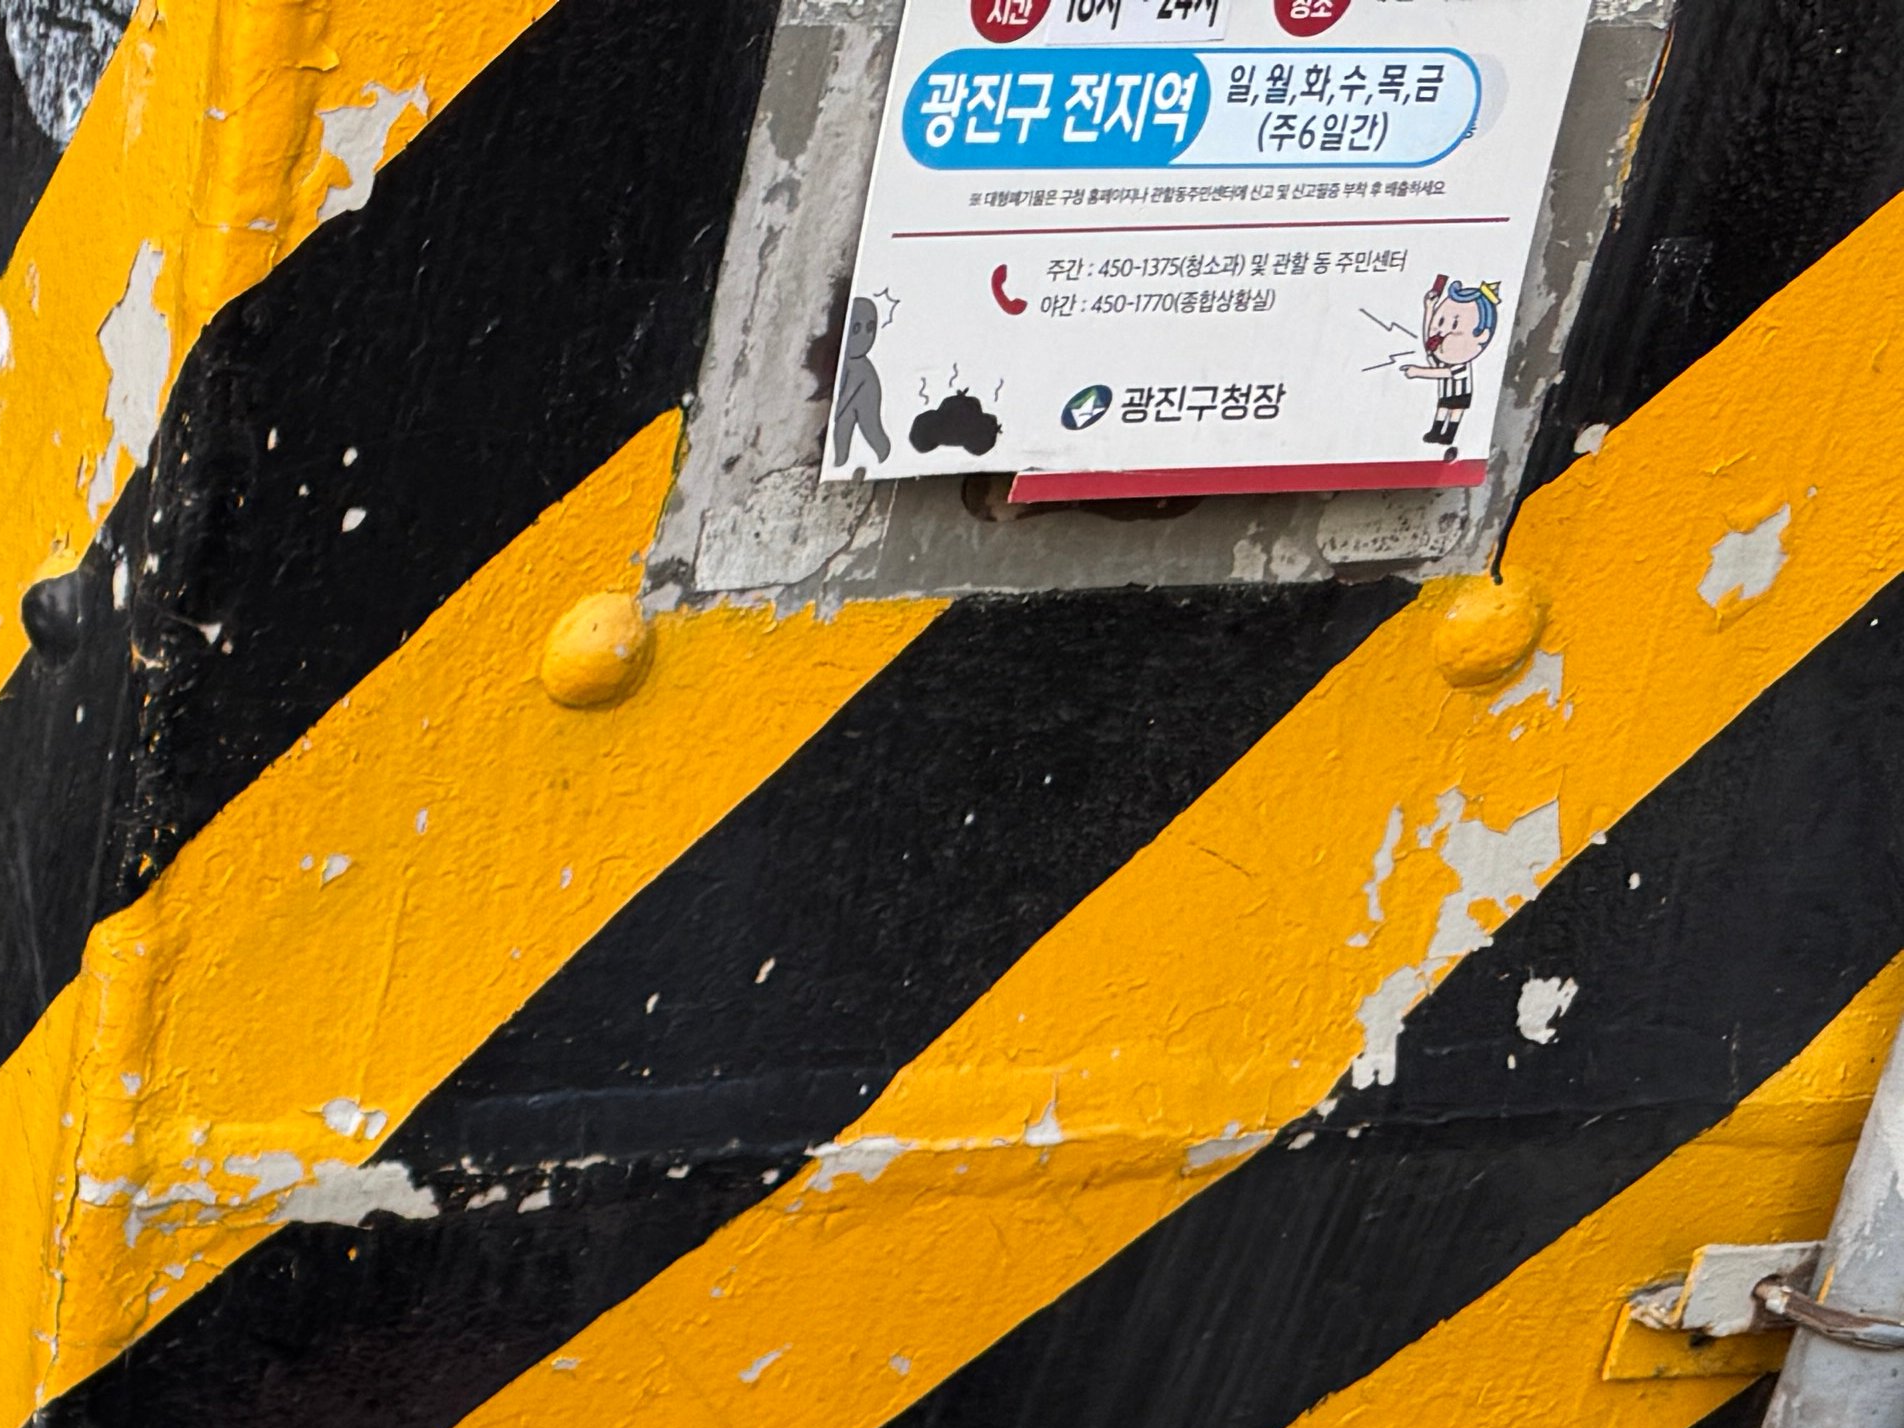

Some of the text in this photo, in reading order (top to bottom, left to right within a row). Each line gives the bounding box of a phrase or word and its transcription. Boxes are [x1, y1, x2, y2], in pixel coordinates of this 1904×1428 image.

[1225, 62, 1446, 106] 일,월,화,수,목,금
[919, 70, 1200, 145] 광진구 전지역
[1256, 111, 1389, 153] (주6일간)
[984, 189, 1057, 207] 대형폐기물은
[1060, 188, 1086, 206] 구청
[1087, 186, 1149, 205] 홈페이지나
[1150, 184, 1248, 204] 관할동주민센터에
[1250, 184, 1275, 201] 신고
[1277, 183, 1290, 200] 및
[1343, 181, 1368, 198] 부착
[1369, 181, 1382, 197] 후
[1384, 180, 1446, 197] 배출하세요
[1046, 258, 1083, 282] 주간
[1097, 253, 1246, 278] 450-1375(청소과)
[1250, 254, 1269, 276] 및
[1272, 252, 1310, 275] 관할
[1313, 251, 1332, 274] 동
[1334, 249, 1409, 274] 주민센터
[1040, 292, 1078, 318] 야간
[1090, 287, 1277, 315] 450-1770(종합상황실)
[1120, 382, 1287, 424] 광진구청장
